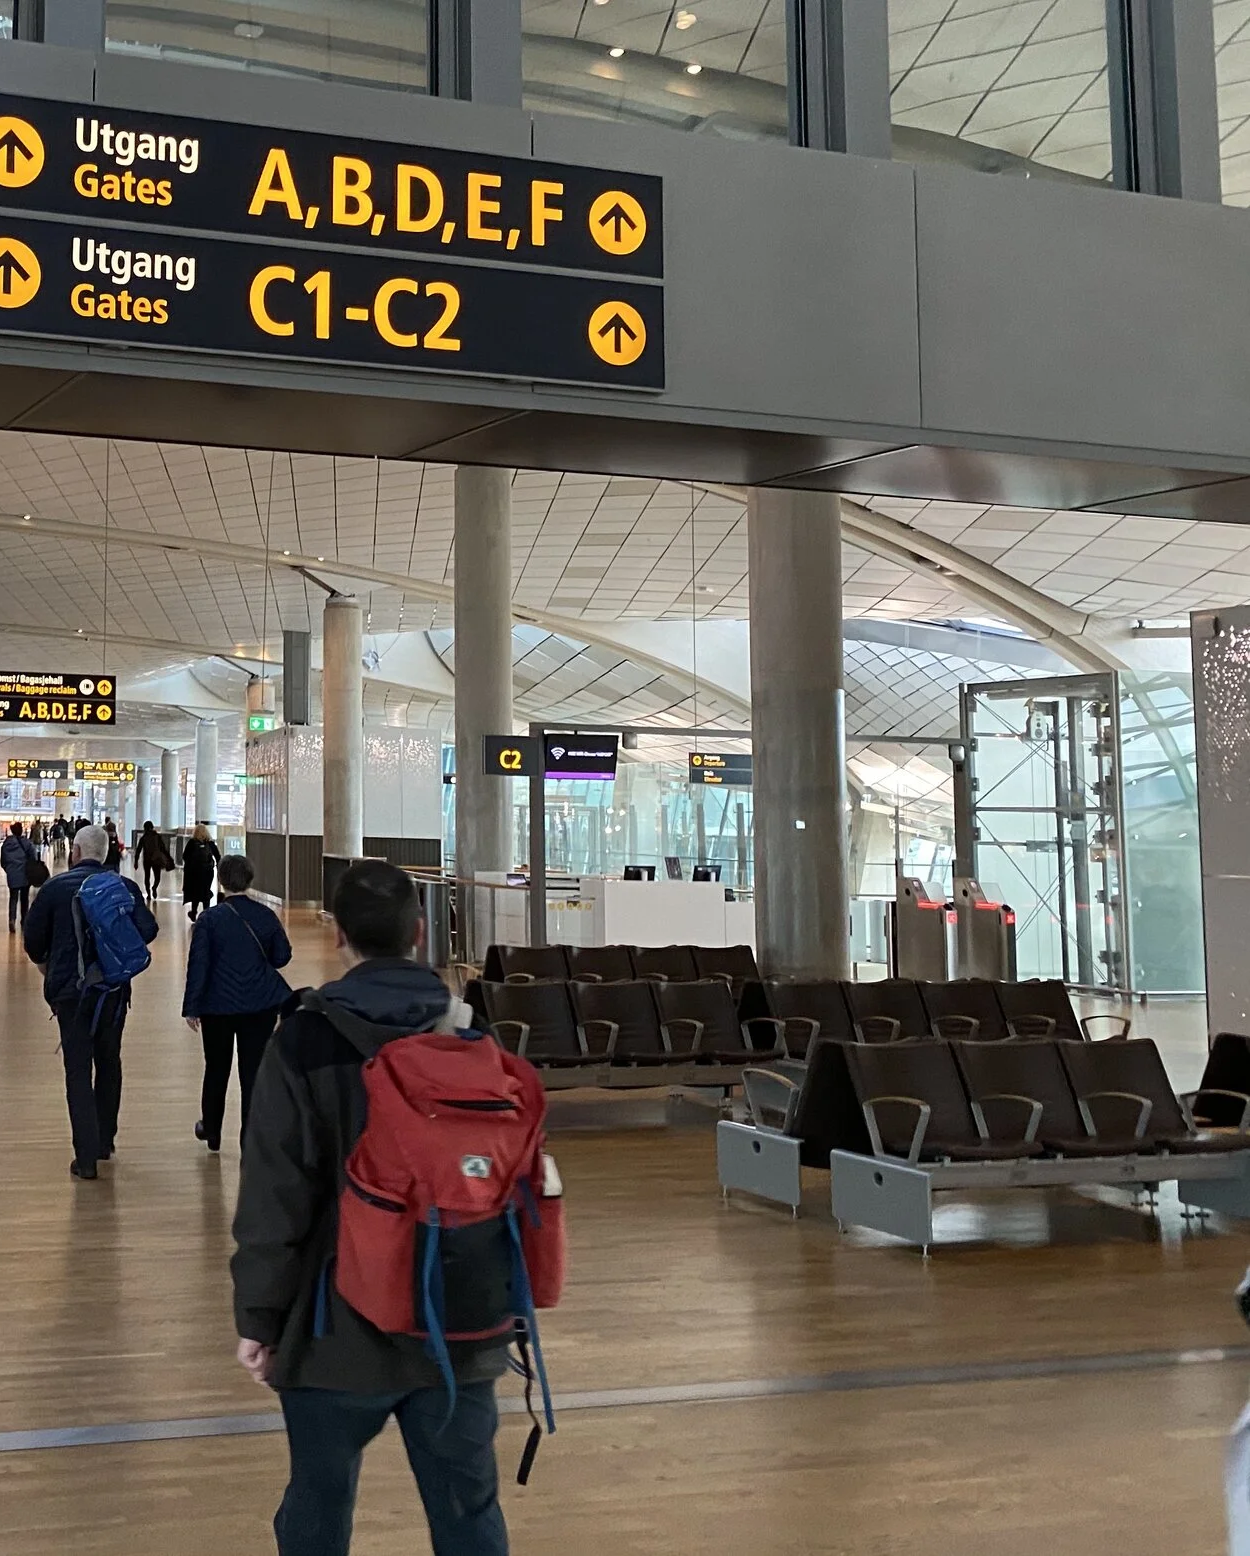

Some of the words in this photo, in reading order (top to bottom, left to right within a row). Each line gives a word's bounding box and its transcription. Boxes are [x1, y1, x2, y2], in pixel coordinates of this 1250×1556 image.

[73, 163, 173, 206] Gates
[75, 117, 199, 174] Utgang
[248, 148, 564, 251] A,B,D,E,F
[70, 283, 169, 325] Gates
[72, 237, 196, 291] Utgang
[249, 265, 461, 352] C1-C2
[16, 684, 48, 695] Baggage
[49, 686, 77, 695] reclaim
[20, 675, 63, 686] Bagasjehall
[30, 760, 39, 768] C1
[500, 749, 522, 769] C2
[230, 839, 241, 849] Ut
